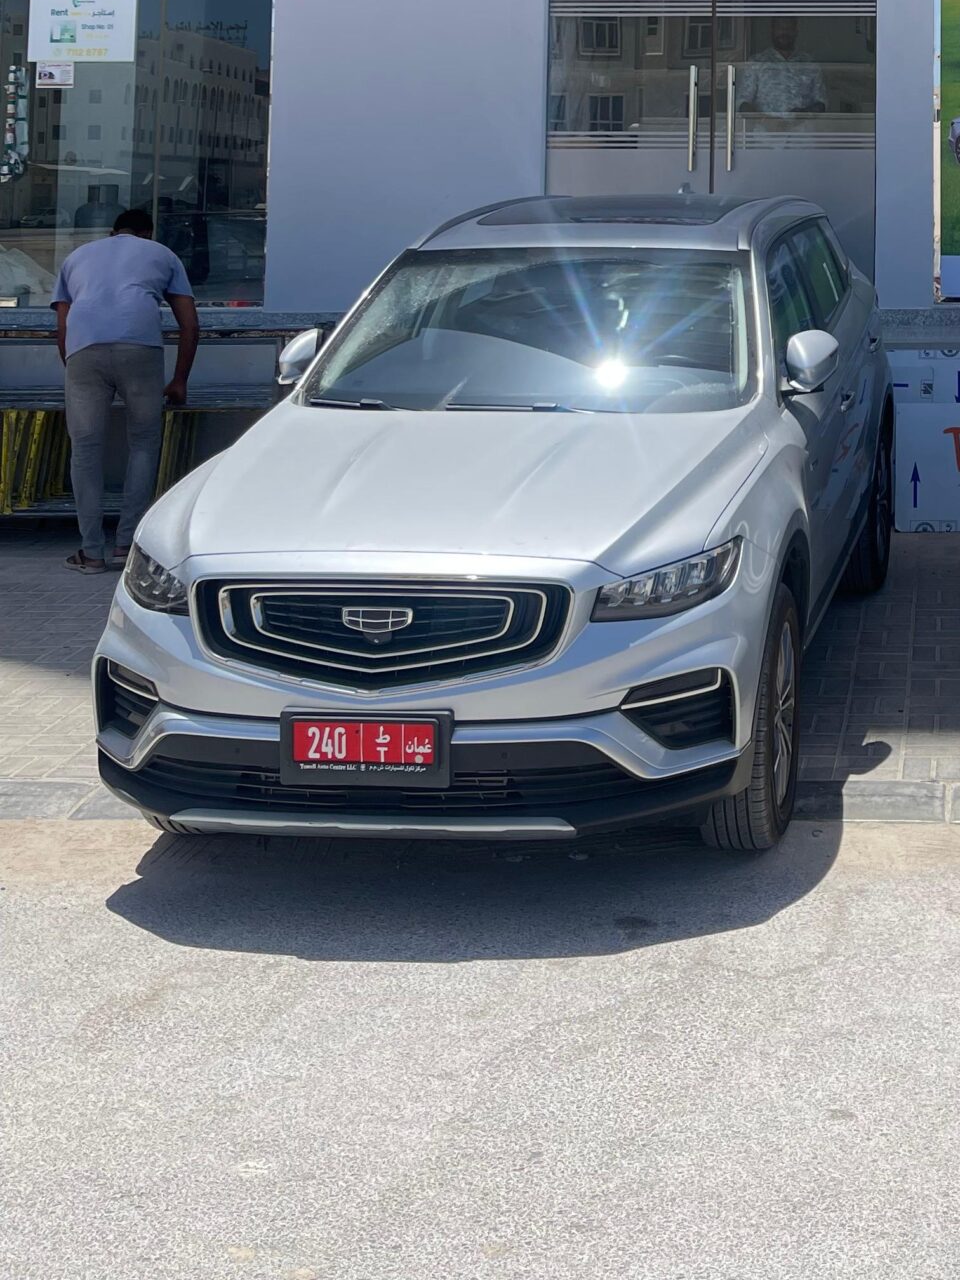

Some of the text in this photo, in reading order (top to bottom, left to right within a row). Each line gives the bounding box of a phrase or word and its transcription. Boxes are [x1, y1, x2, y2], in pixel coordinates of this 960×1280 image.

[50, 8, 69, 17] Rent
[307, 726, 347, 760] 240
[376, 746, 389, 763] T
